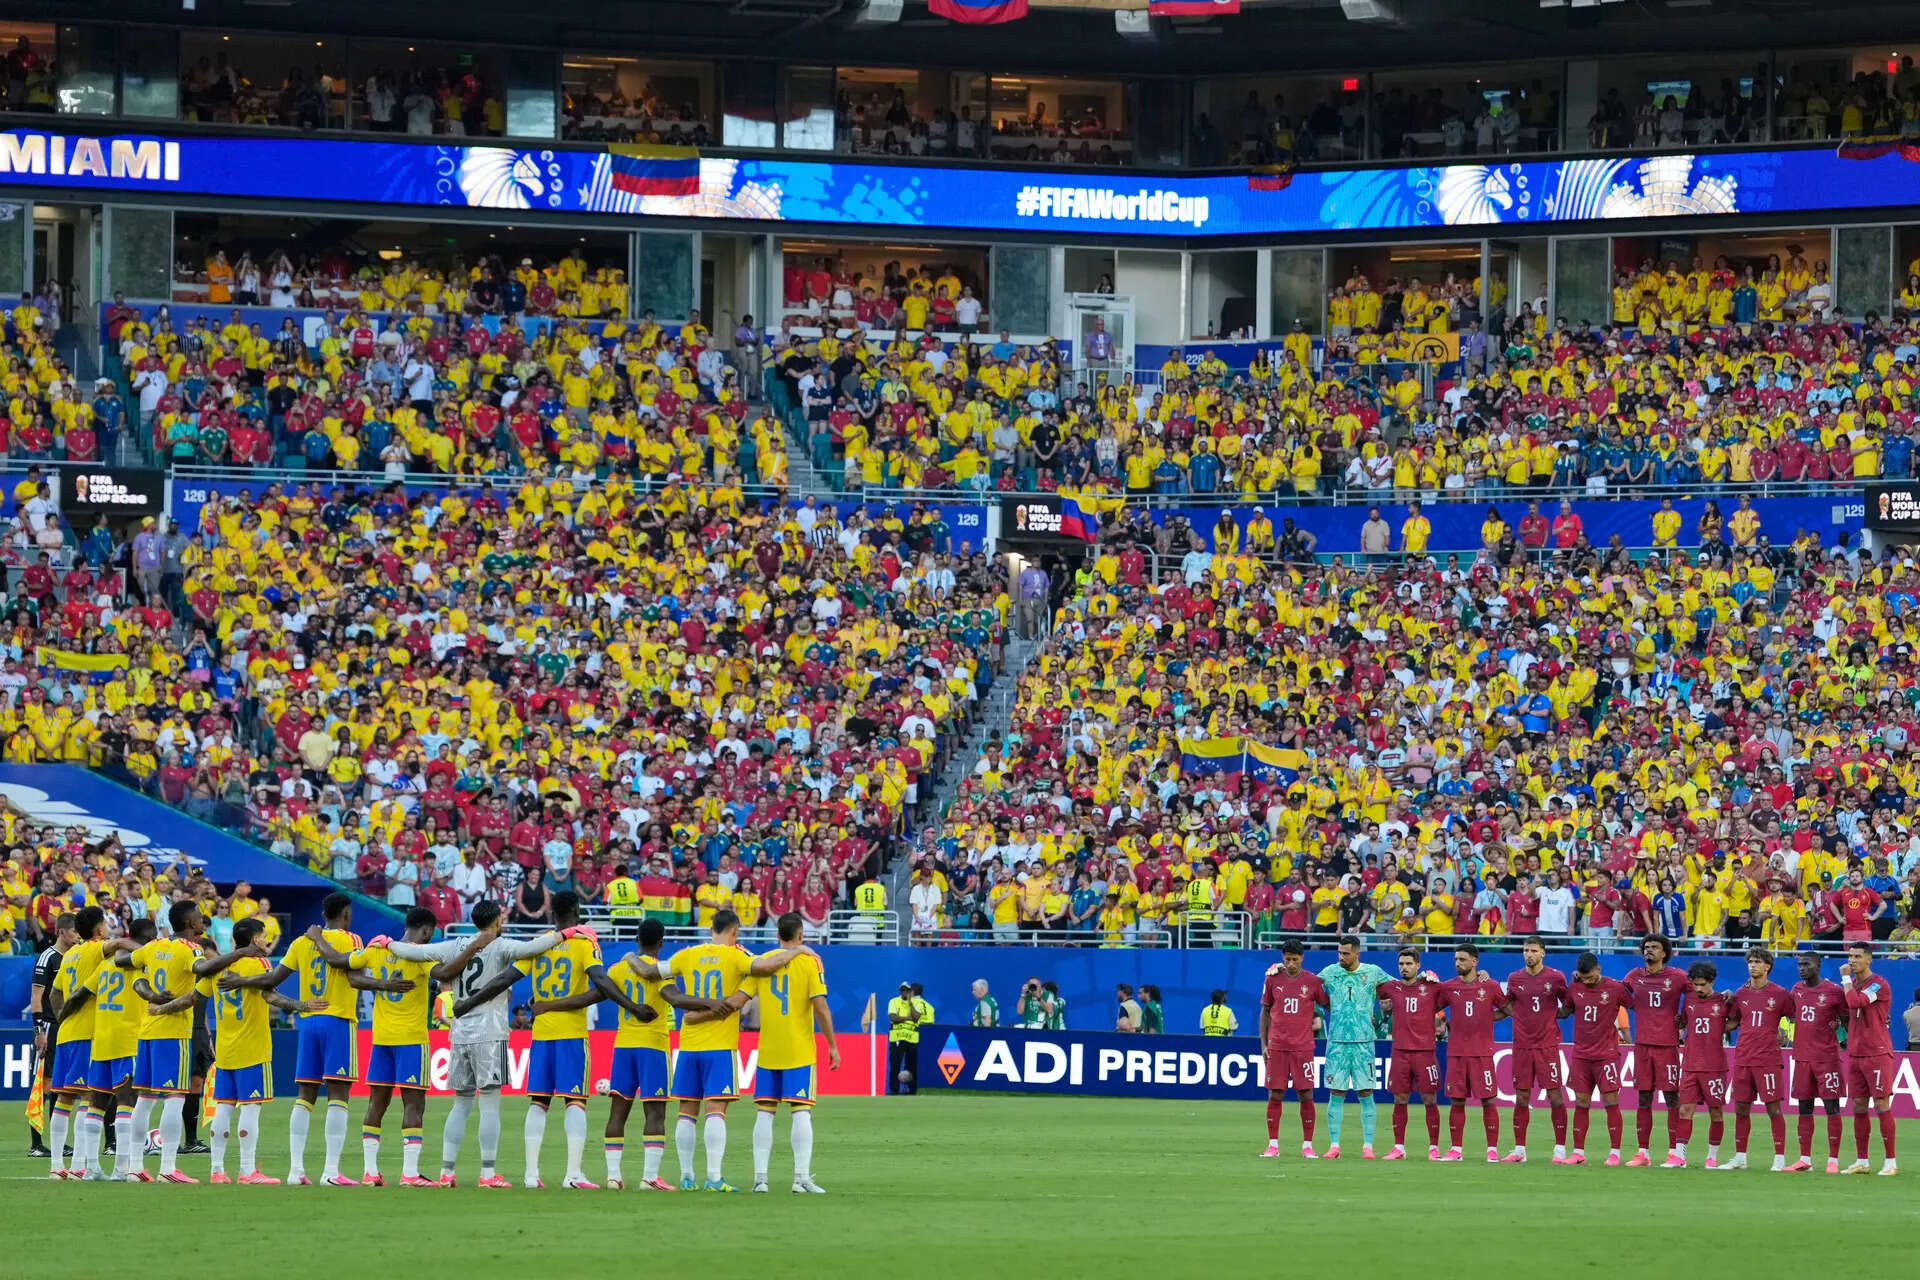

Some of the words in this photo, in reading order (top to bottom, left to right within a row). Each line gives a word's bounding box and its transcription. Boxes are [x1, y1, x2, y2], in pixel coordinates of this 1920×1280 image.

[0, 134, 181, 181] MIAMI
[1016, 186, 1210, 228] #FIFAWorldCup
[90, 475, 113, 485] FIFA
[90, 484, 128, 495] WORLD
[183, 489, 206, 503] 126
[1891, 492, 1913, 501] FIFA
[89, 493, 111, 504] CUP
[1028, 504, 1049, 514] FIFA
[1844, 504, 1865, 517] 129
[1891, 510, 1911, 520] CUP
[957, 513, 979, 526] 126
[1028, 513, 1062, 523] WORLD
[1028, 522, 1048, 531] CUP
[310, 956, 326, 997] 3
[458, 956, 484, 998] 12
[535, 955, 571, 998] 23
[692, 969, 723, 1001] 10
[98, 970, 124, 1011] 22
[770, 974, 789, 1016] 4
[1347, 986, 1352, 1001] 1
[1283, 998, 1299, 1014] 20
[1405, 997, 1418, 1013] 18
[1532, 996, 1540, 1012] 3
[1648, 991, 1661, 1008] 13
[1465, 1001, 1473, 1017] 8
[1583, 1005, 1597, 1022] 21
[1800, 1005, 1816, 1022] 25
[1695, 1017, 1710, 1034] 23
[1751, 1011, 1763, 1027] 11
[974, 1039, 1084, 1086] ADI
[1302, 1061, 1315, 1078] 20
[1549, 1062, 1558, 1079] 3
[1426, 1065, 1439, 1082] 18
[1484, 1070, 1493, 1086] 8
[1603, 1062, 1618, 1081] 21
[1666, 1064, 1678, 1081] 13
[1873, 1069, 1881, 1086] 7
[1708, 1078, 1724, 1096] 23
[1763, 1073, 1776, 1090] 11
[1824, 1072, 1840, 1089] 25
